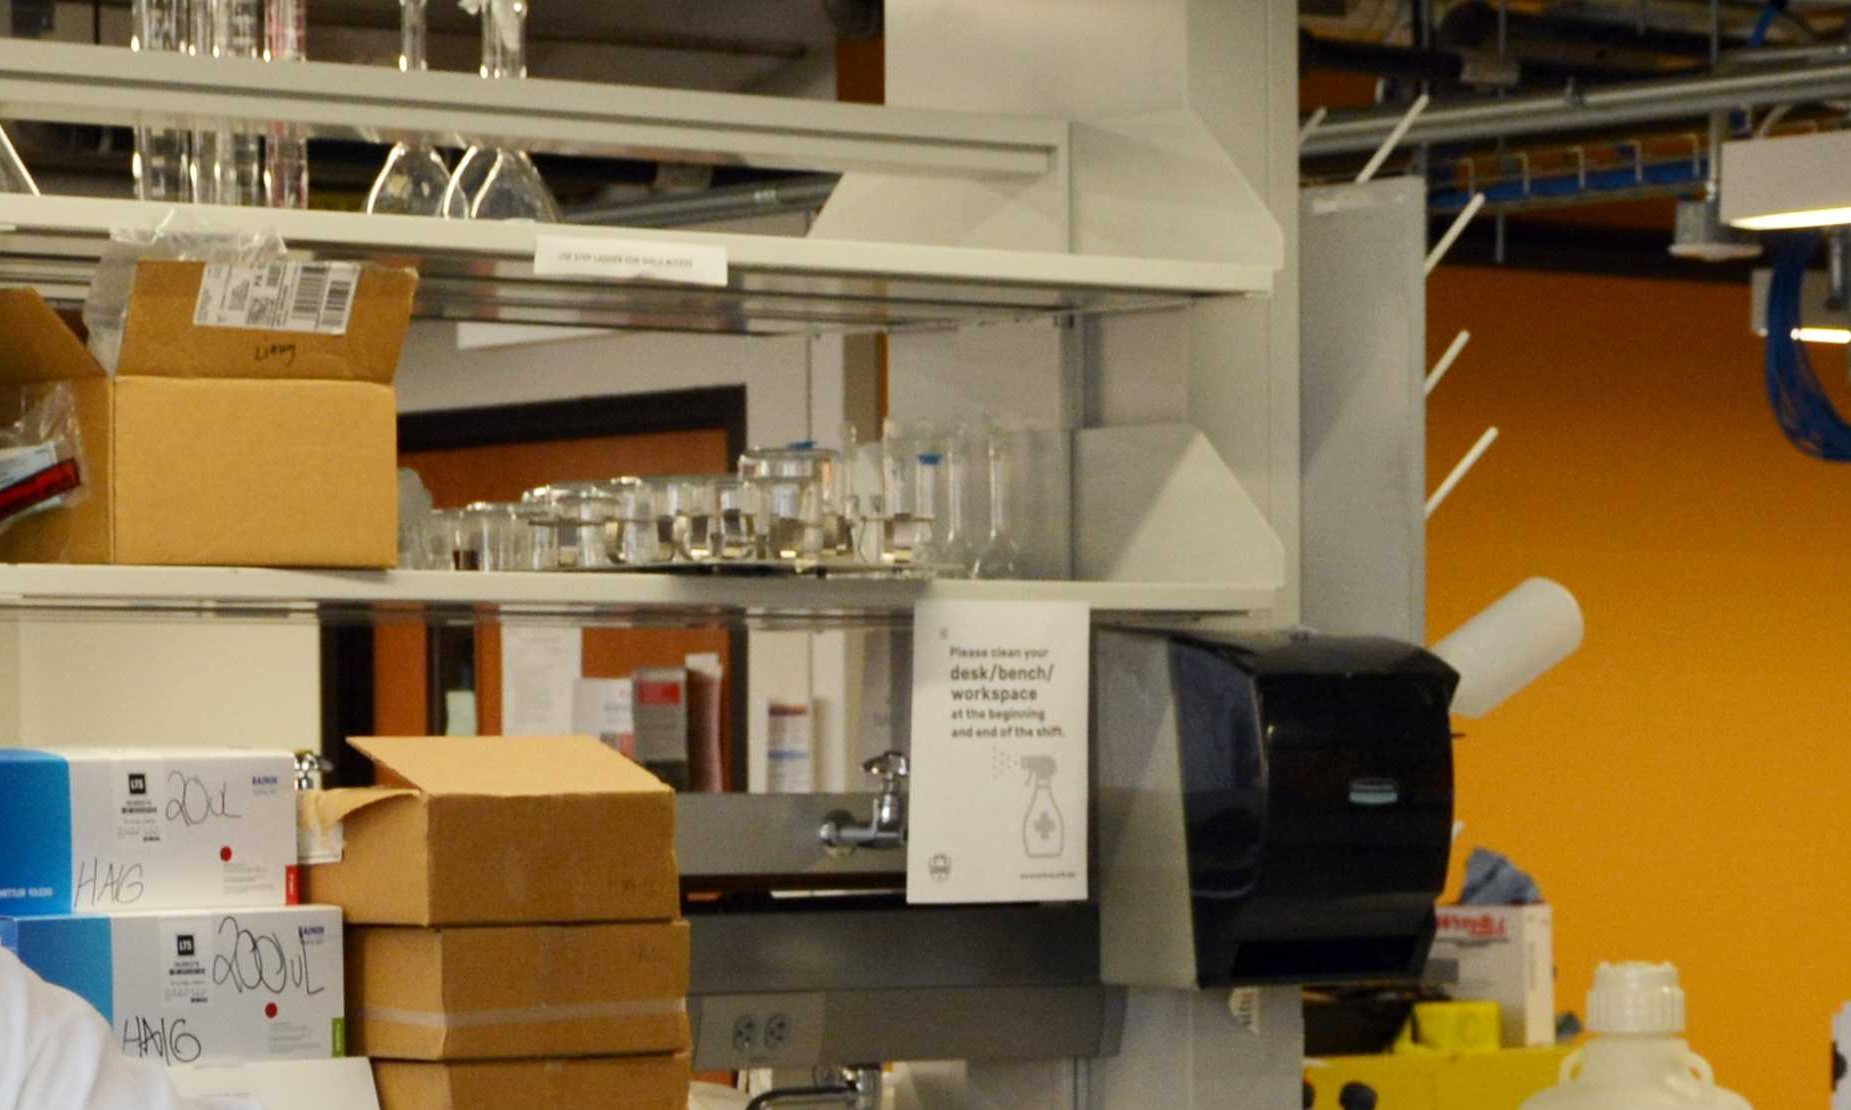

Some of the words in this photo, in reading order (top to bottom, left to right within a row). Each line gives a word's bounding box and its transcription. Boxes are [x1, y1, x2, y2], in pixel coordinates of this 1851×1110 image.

[950, 647, 988, 657] Please
[991, 647, 1022, 657] clean
[1024, 649, 1048, 661] your
[950, 663, 1055, 682] desk/bench/
[951, 686, 1038, 703] workspace
[951, 709, 963, 719] at
[966, 709, 986, 719] the
[988, 709, 1044, 722] beginning
[951, 727, 973, 737] and
[975, 726, 997, 737] end
[1000, 726, 1012, 737] of
[1014, 726, 1033, 737] the
